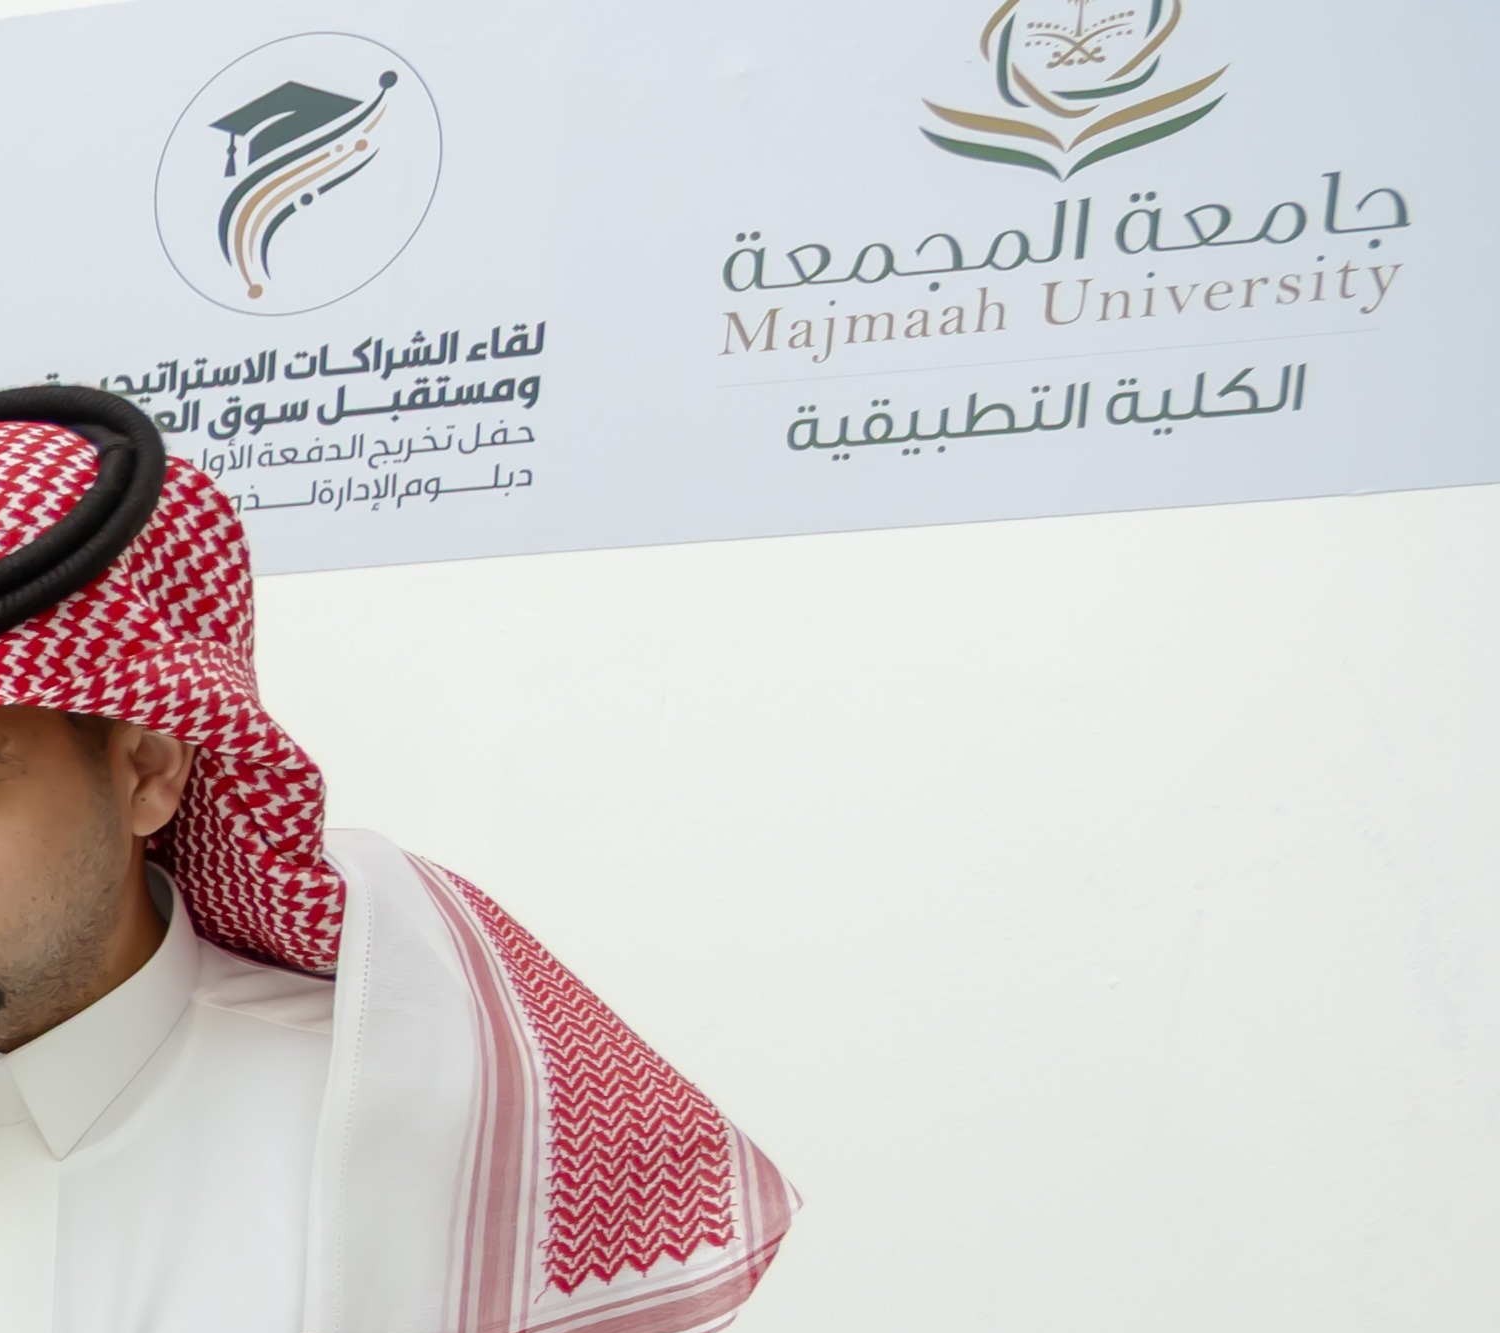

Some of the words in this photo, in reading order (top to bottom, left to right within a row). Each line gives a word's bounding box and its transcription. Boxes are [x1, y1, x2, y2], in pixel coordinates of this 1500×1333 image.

[1113, 170, 1411, 255] جامعة
[720, 196, 1091, 293] المجمعة
[717, 286, 1007, 364] Majmaah
[1041, 255, 1405, 327] University
[284, 328, 459, 382] الشراكات
[466, 319, 547, 363] لقاء
[210, 393, 308, 440] سوق
[317, 375, 542, 427] ومستقبل
[785, 380, 1091, 462] التطبيقية
[1104, 362, 1307, 437] الكلية
[187, 437, 252, 479] الأول
[257, 433, 365, 468] الدفعة
[367, 426, 454, 468] تخريج
[457, 418, 536, 454] حفل
[319, 473, 397, 511] الإدارة
[397, 463, 533, 509] دبلوم
